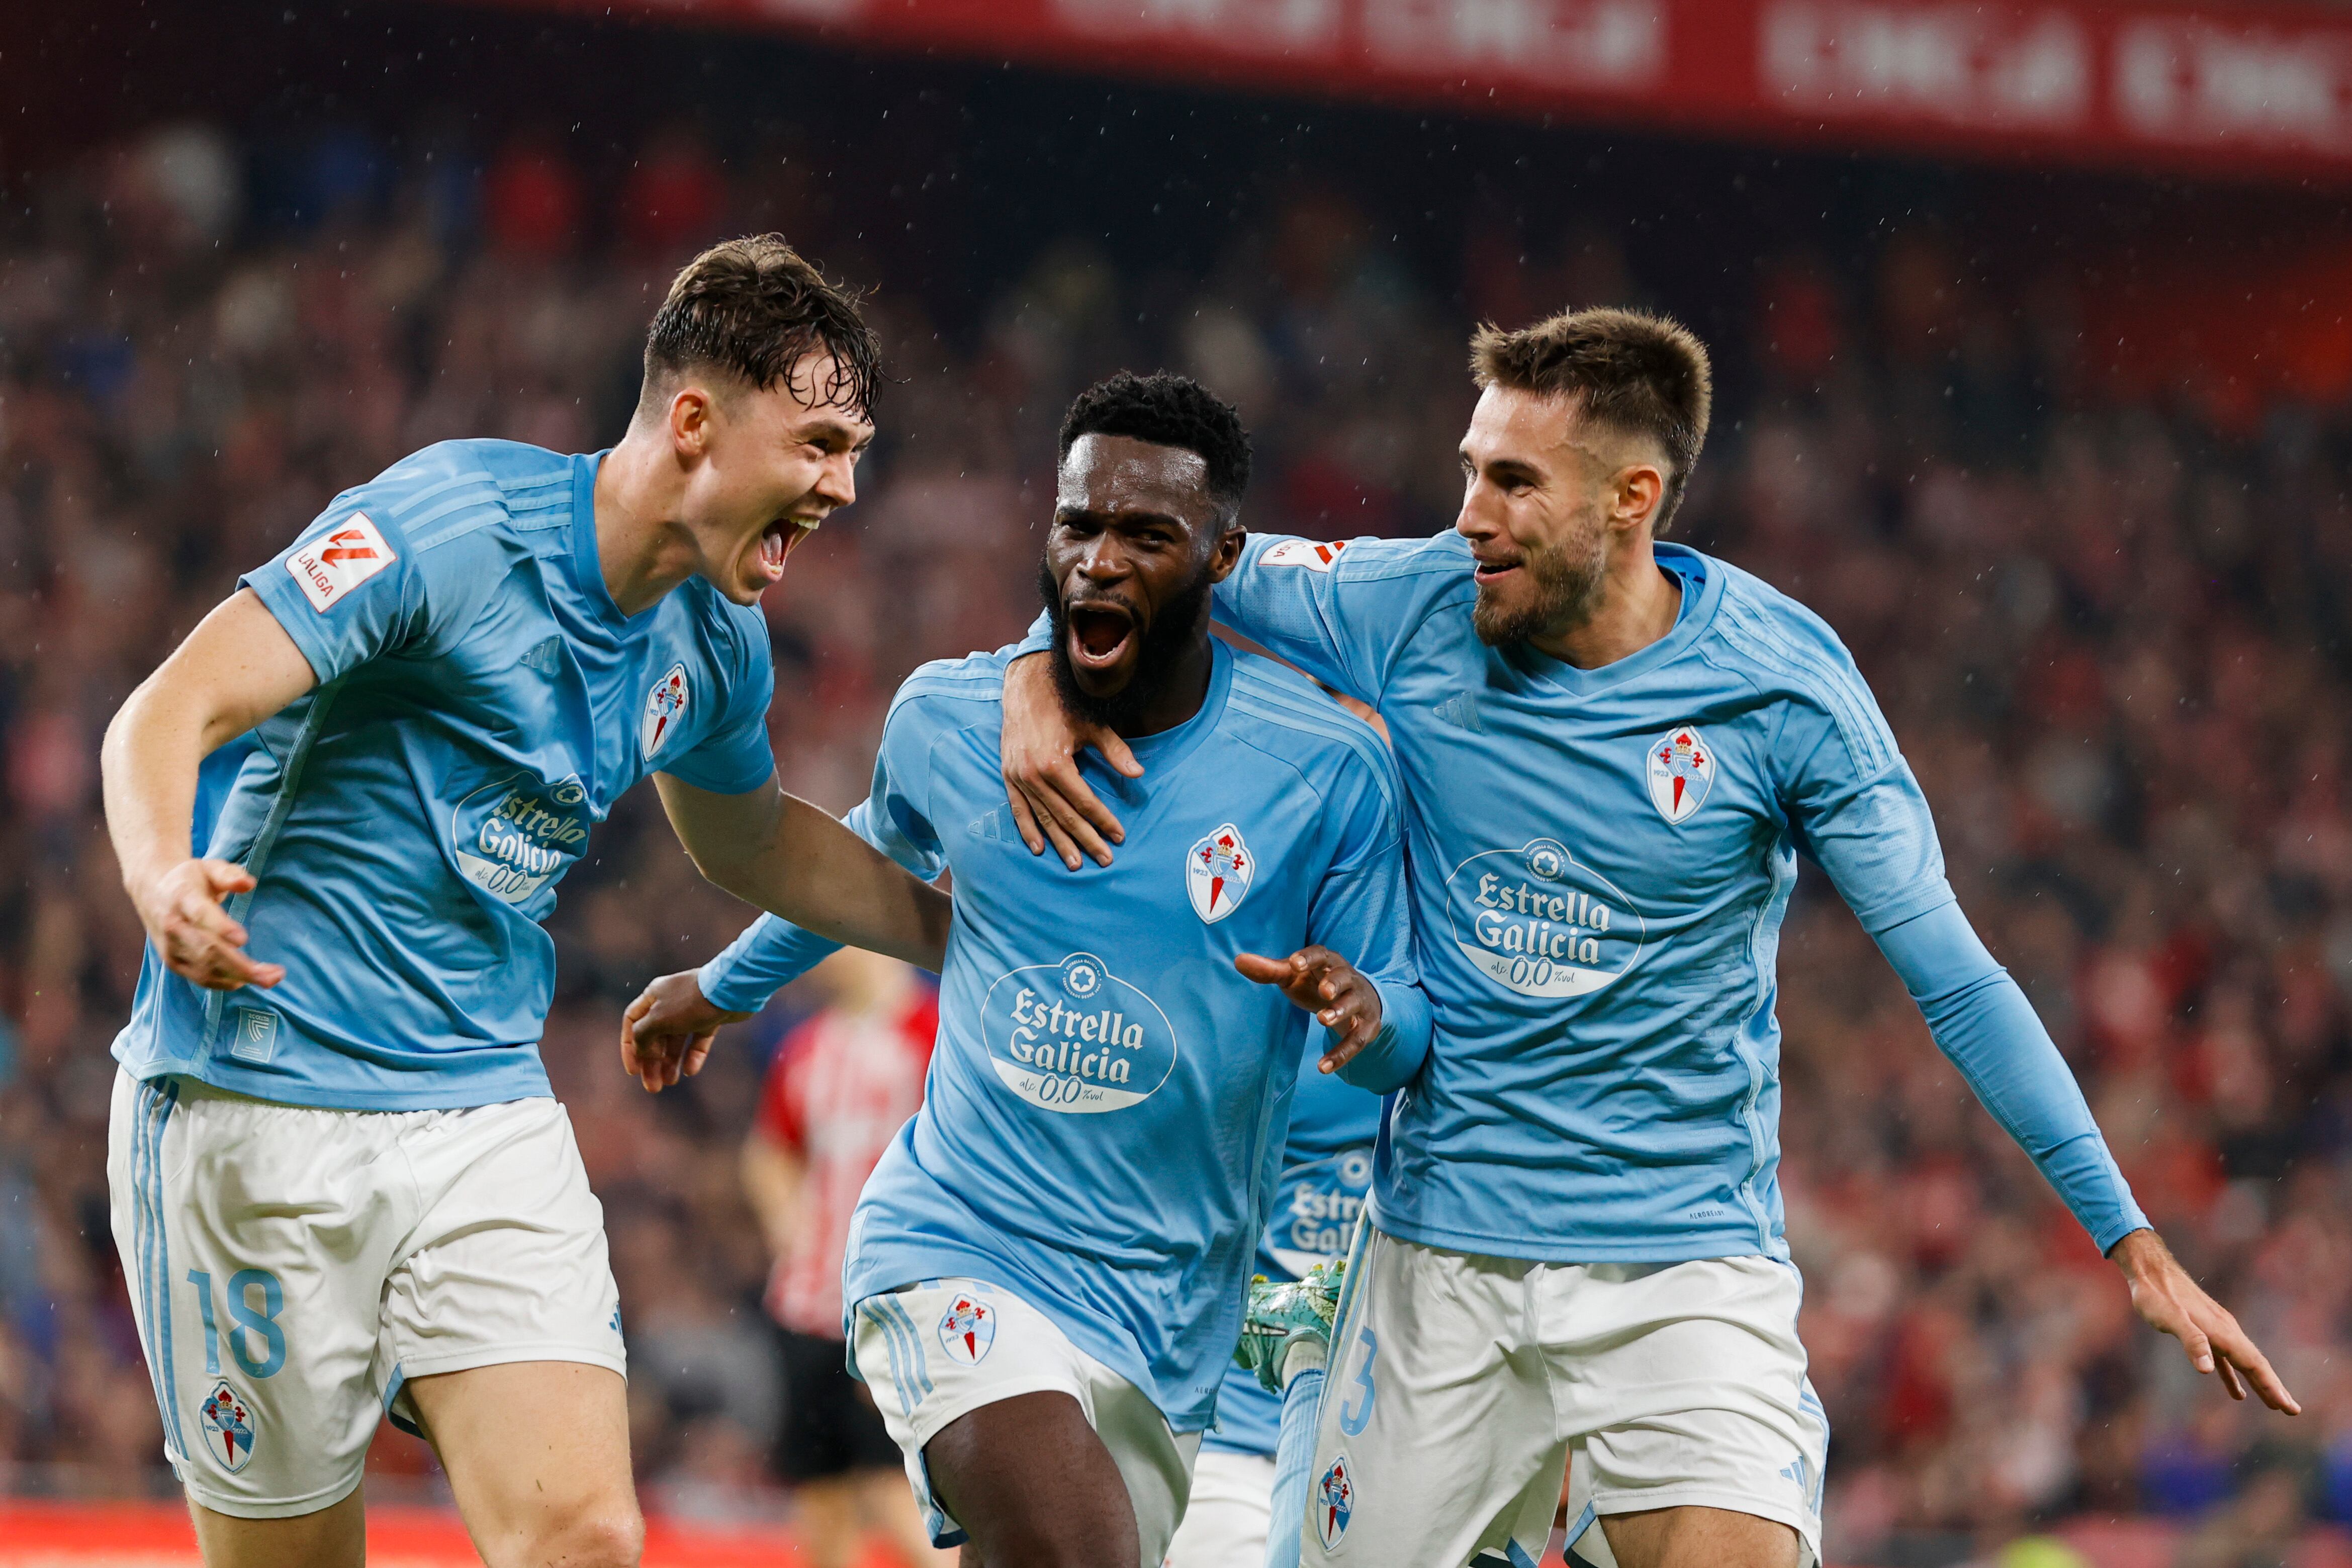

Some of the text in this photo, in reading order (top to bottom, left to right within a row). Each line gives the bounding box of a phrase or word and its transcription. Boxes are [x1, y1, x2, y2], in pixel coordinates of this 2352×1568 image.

[298, 552, 334, 597] LALIGA
[1654, 769, 1669, 777] 1923
[488, 866, 526, 894] 0,0
[1193, 867, 1208, 876] 1923
[1224, 875, 1241, 884] 2023
[1474, 872, 1610, 932] Estrella
[1475, 909, 1600, 965] Galicia
[1491, 961, 1508, 974] alc.
[1510, 957, 1552, 987] 0,0
[1011, 988, 1143, 1050] Estrella
[1010, 1026, 1130, 1084] Galicia
[1019, 1078, 1037, 1091] alc.
[1039, 1075, 1081, 1103] 0,0
[1288, 1183, 1366, 1221] Estr
[1690, 1210, 1725, 1220] AEROREADY
[187, 1268, 286, 1379] 18
[1339, 1325, 1378, 1437] 3
